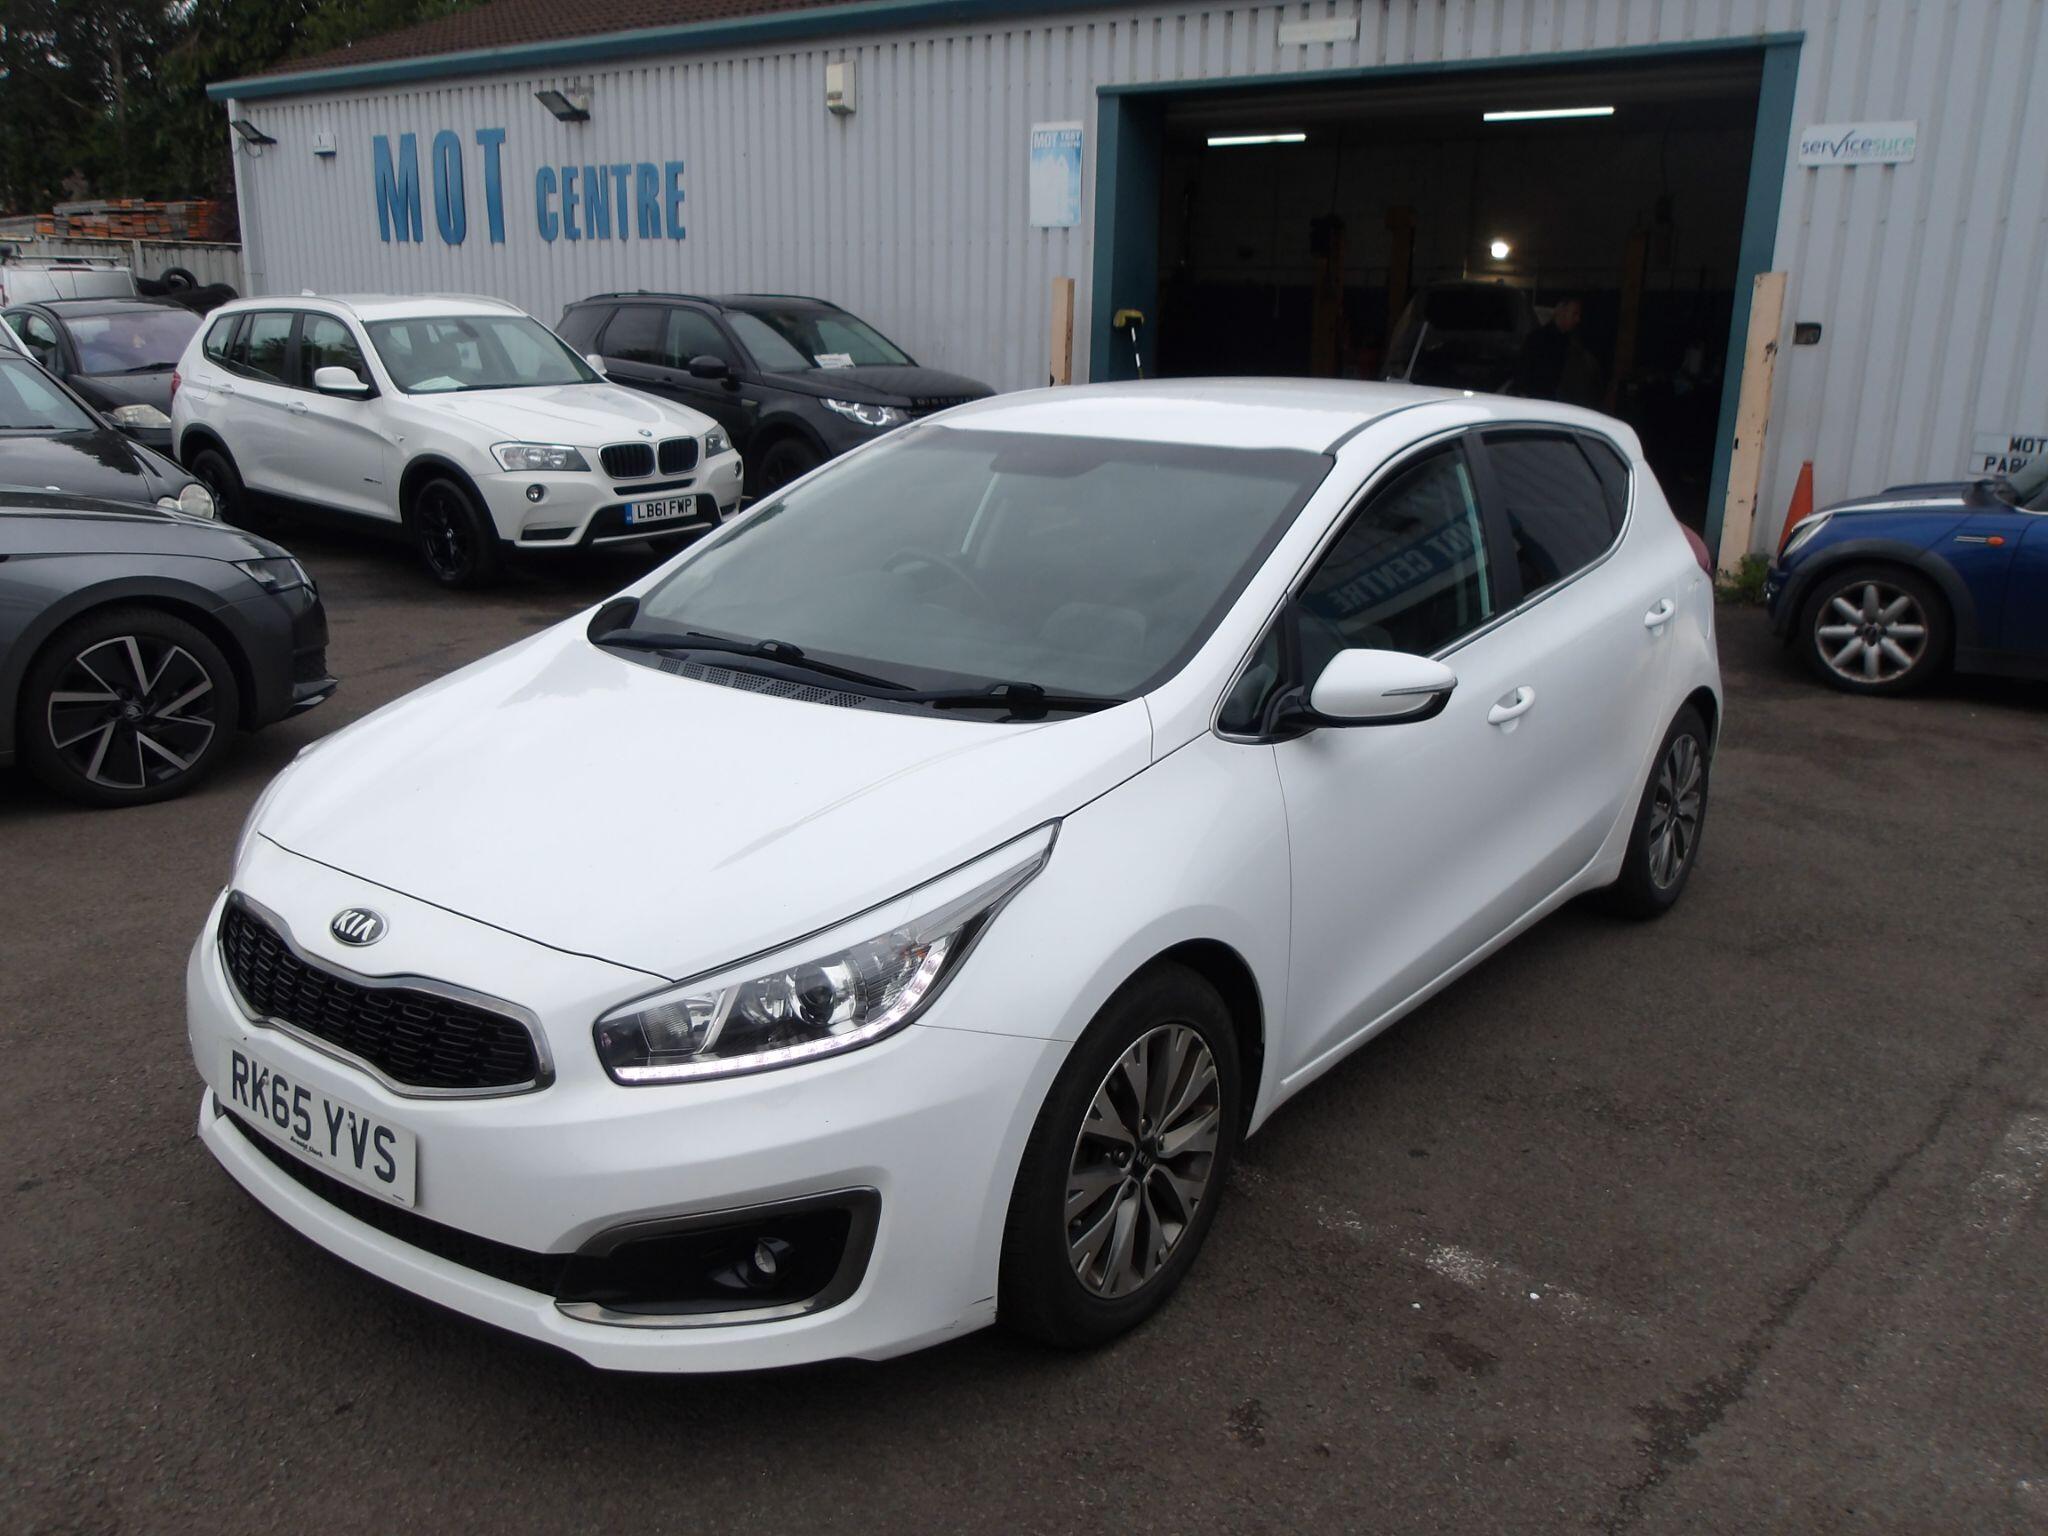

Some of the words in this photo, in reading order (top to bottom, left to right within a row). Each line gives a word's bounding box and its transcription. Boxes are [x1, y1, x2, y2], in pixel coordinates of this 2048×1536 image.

[1801, 129, 1915, 157] servicesure
[373, 128, 506, 245] MOT
[536, 160, 686, 241] CENTRE
[2008, 437, 2048, 454] MOT
[637, 503, 667, 519] LB61
[669, 498, 692, 515] FWP
[333, 910, 377, 941] KIA
[232, 1050, 312, 1142] RK65
[324, 1098, 397, 1184] YVS
